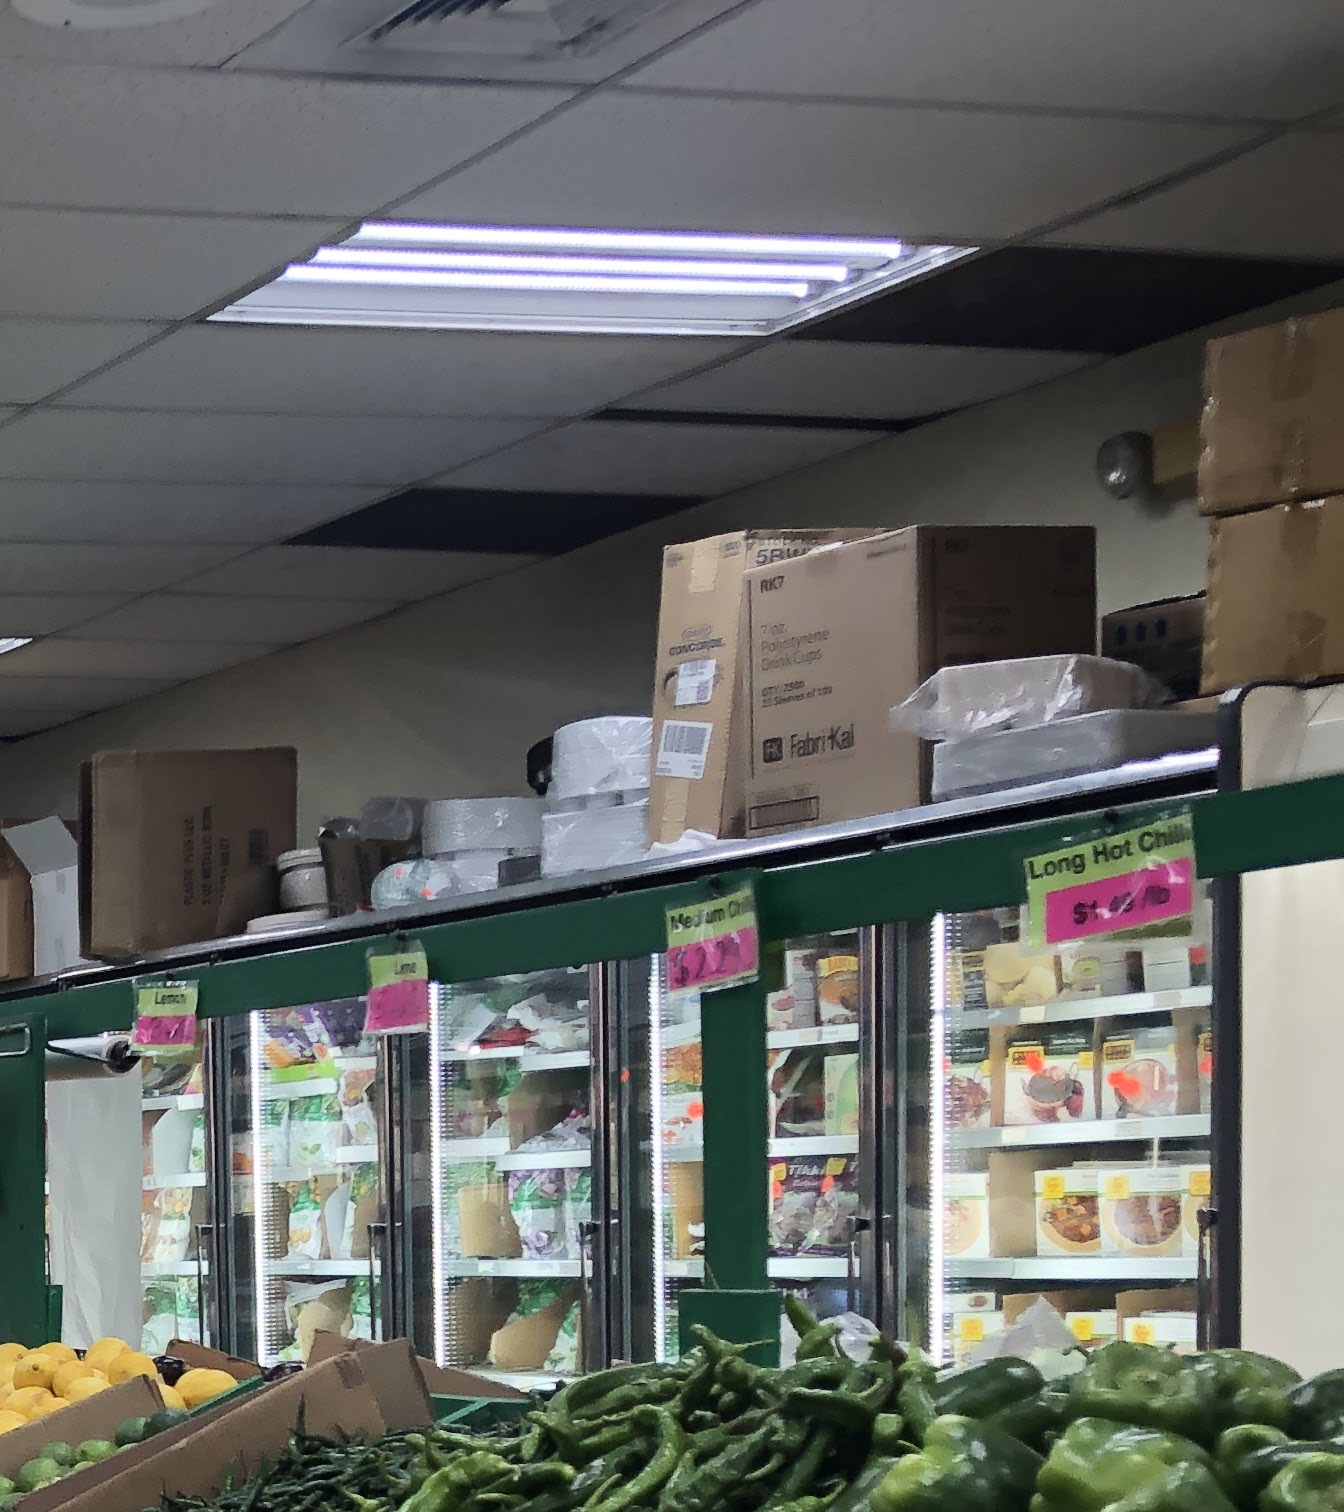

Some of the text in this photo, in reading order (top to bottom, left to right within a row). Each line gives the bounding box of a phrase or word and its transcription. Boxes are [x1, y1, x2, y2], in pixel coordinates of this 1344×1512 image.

[760, 575, 785, 593] RK7
[1028, 853, 1086, 880] Long
[1092, 839, 1134, 864] Hot
[154, 990, 187, 1006] Lemon
